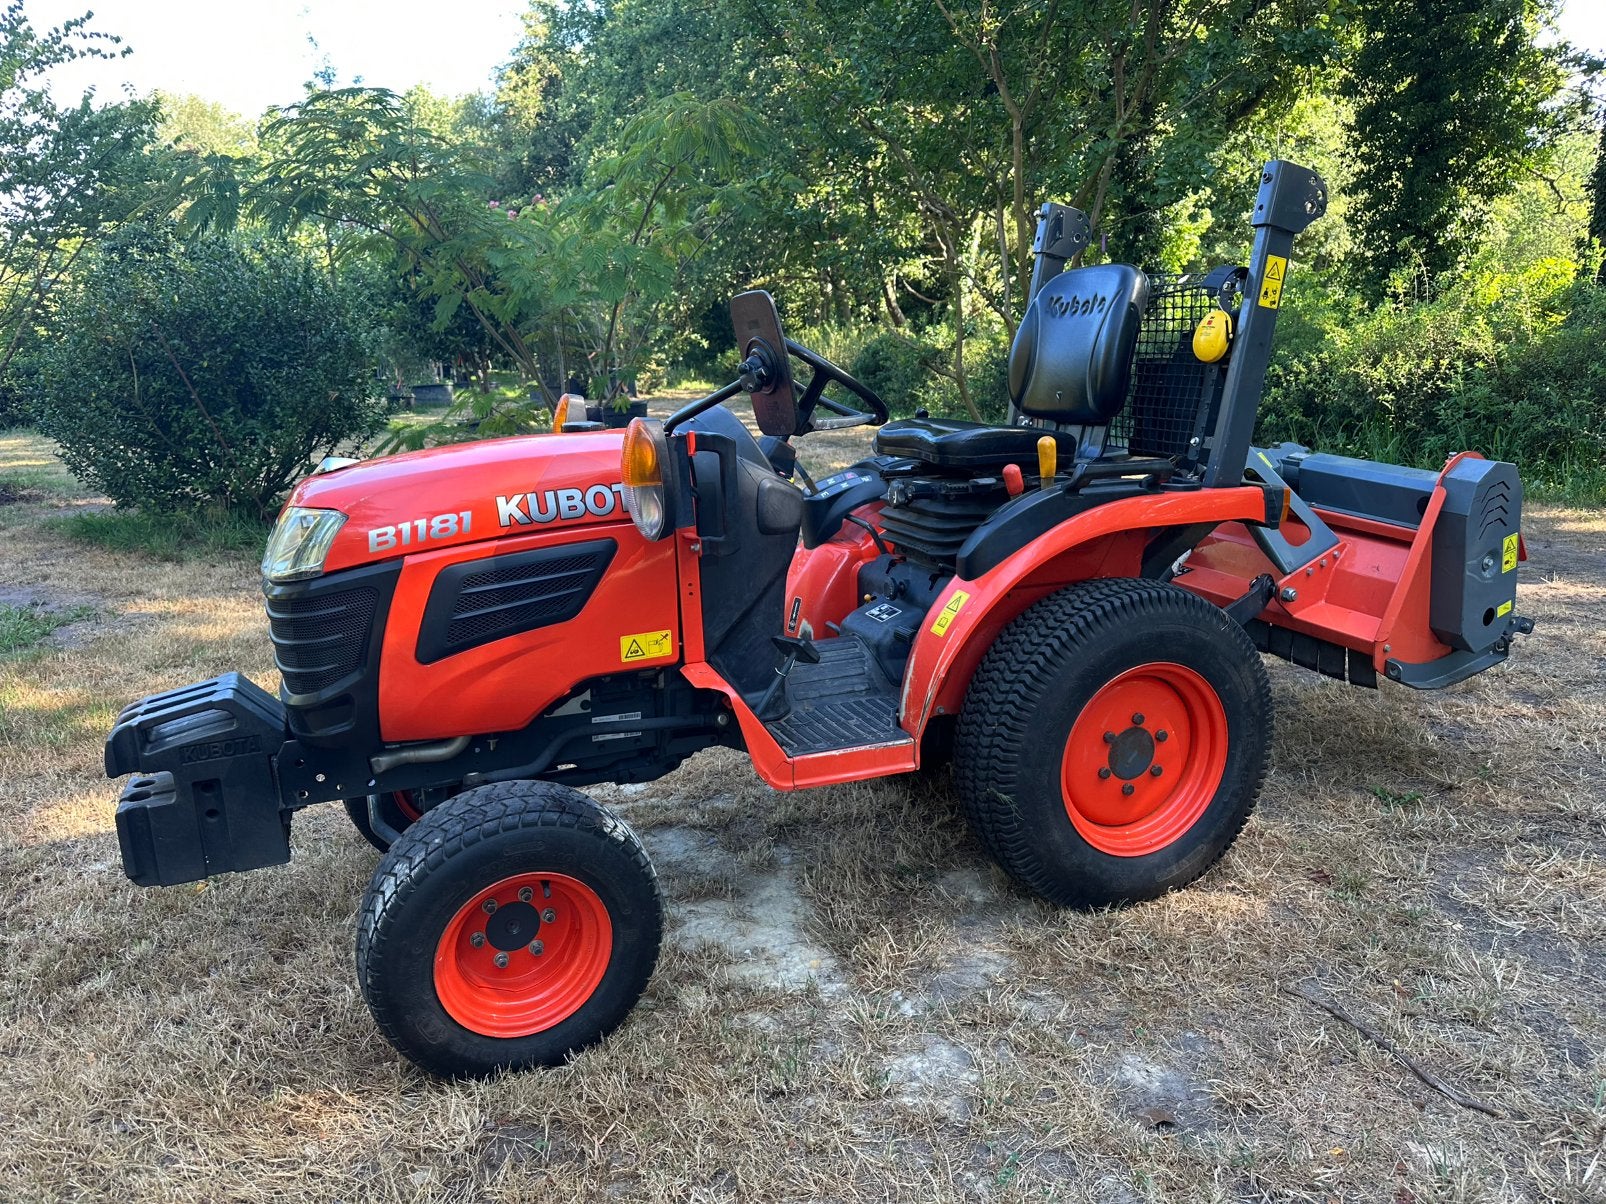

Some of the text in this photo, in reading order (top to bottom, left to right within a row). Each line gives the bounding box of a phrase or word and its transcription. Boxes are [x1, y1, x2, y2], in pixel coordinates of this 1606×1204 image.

[495, 482, 630, 527] KUBOT
[368, 511, 472, 553] B1181
[182, 735, 262, 763] KUBOTA
